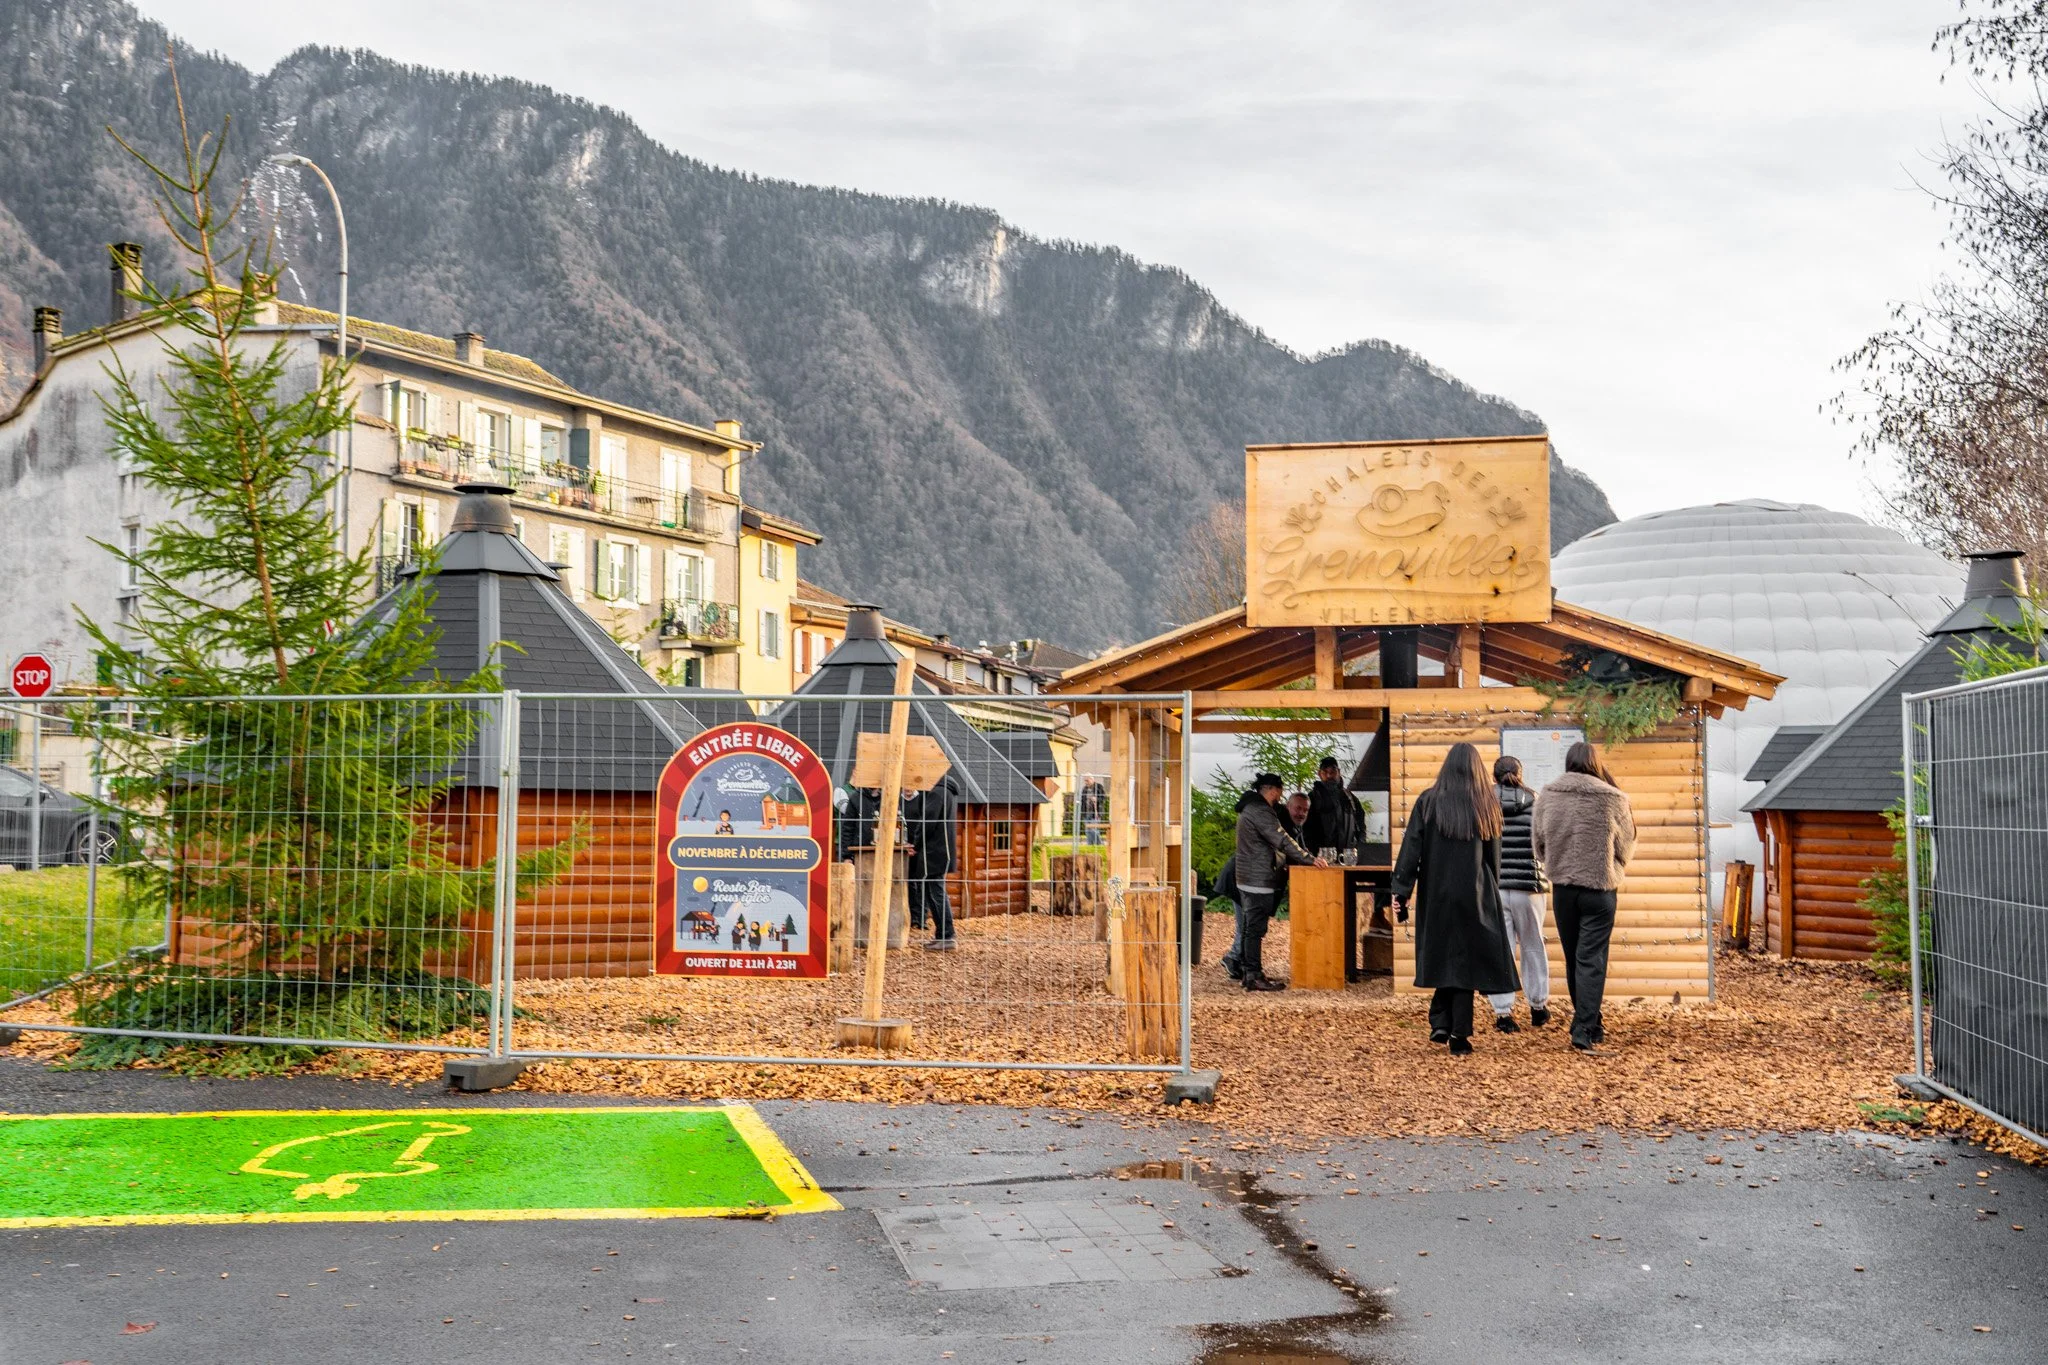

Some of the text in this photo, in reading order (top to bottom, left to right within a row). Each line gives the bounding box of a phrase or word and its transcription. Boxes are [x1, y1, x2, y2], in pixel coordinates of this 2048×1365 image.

[1310, 449, 1500, 505] CHALETS DES
[1260, 534, 1549, 597] Grenouilles
[1321, 605, 1490, 624] VILLENEUVE
[16, 669, 49, 686] STOP
[688, 728, 804, 768] ENTRÉE LIBRE
[677, 845, 809, 860] NOVEMBRE À DÉCEMBRE
[713, 879, 772, 893] Resto Bar
[711, 892, 772, 907] sous igloo
[685, 957, 797, 970] OUVERT DE 11H À 23H
